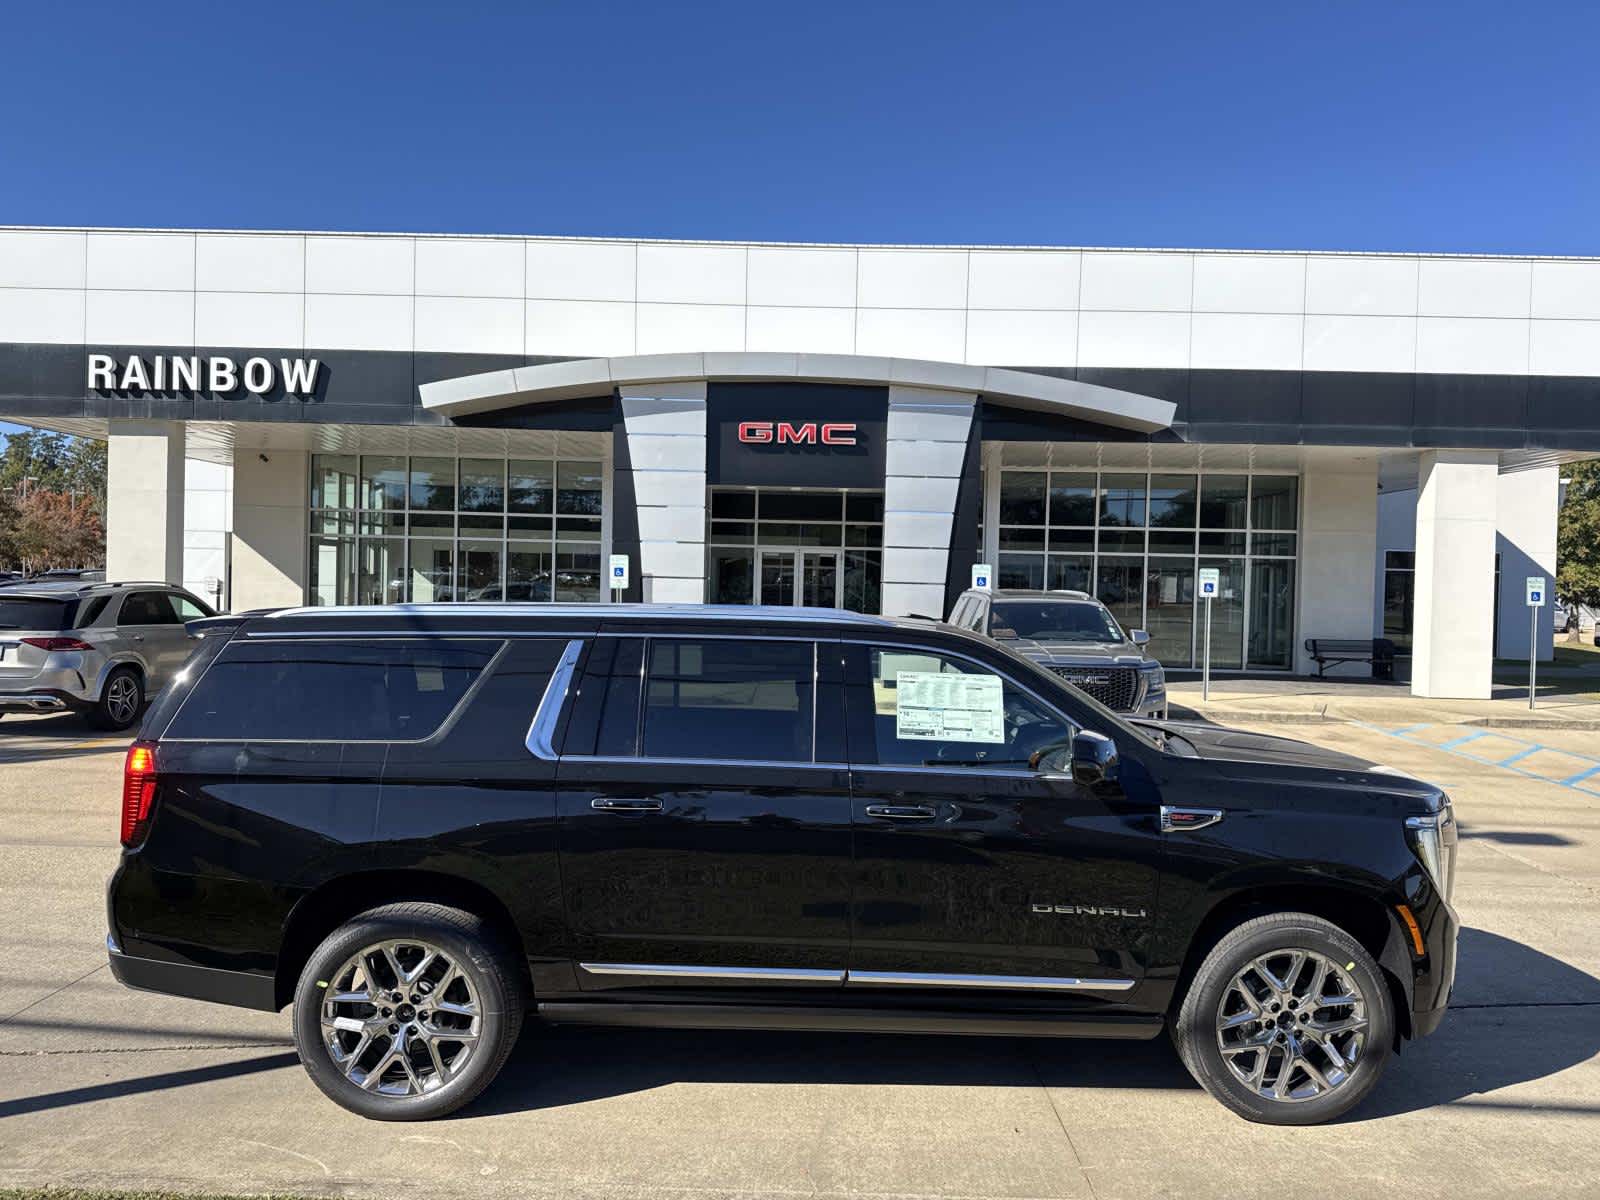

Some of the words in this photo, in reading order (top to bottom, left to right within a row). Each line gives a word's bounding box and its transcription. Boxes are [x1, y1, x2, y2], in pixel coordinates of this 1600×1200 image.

[88, 354, 317, 393] RAINBOW
[738, 422, 857, 445] GMC
[1032, 903, 1146, 917] DENALI
